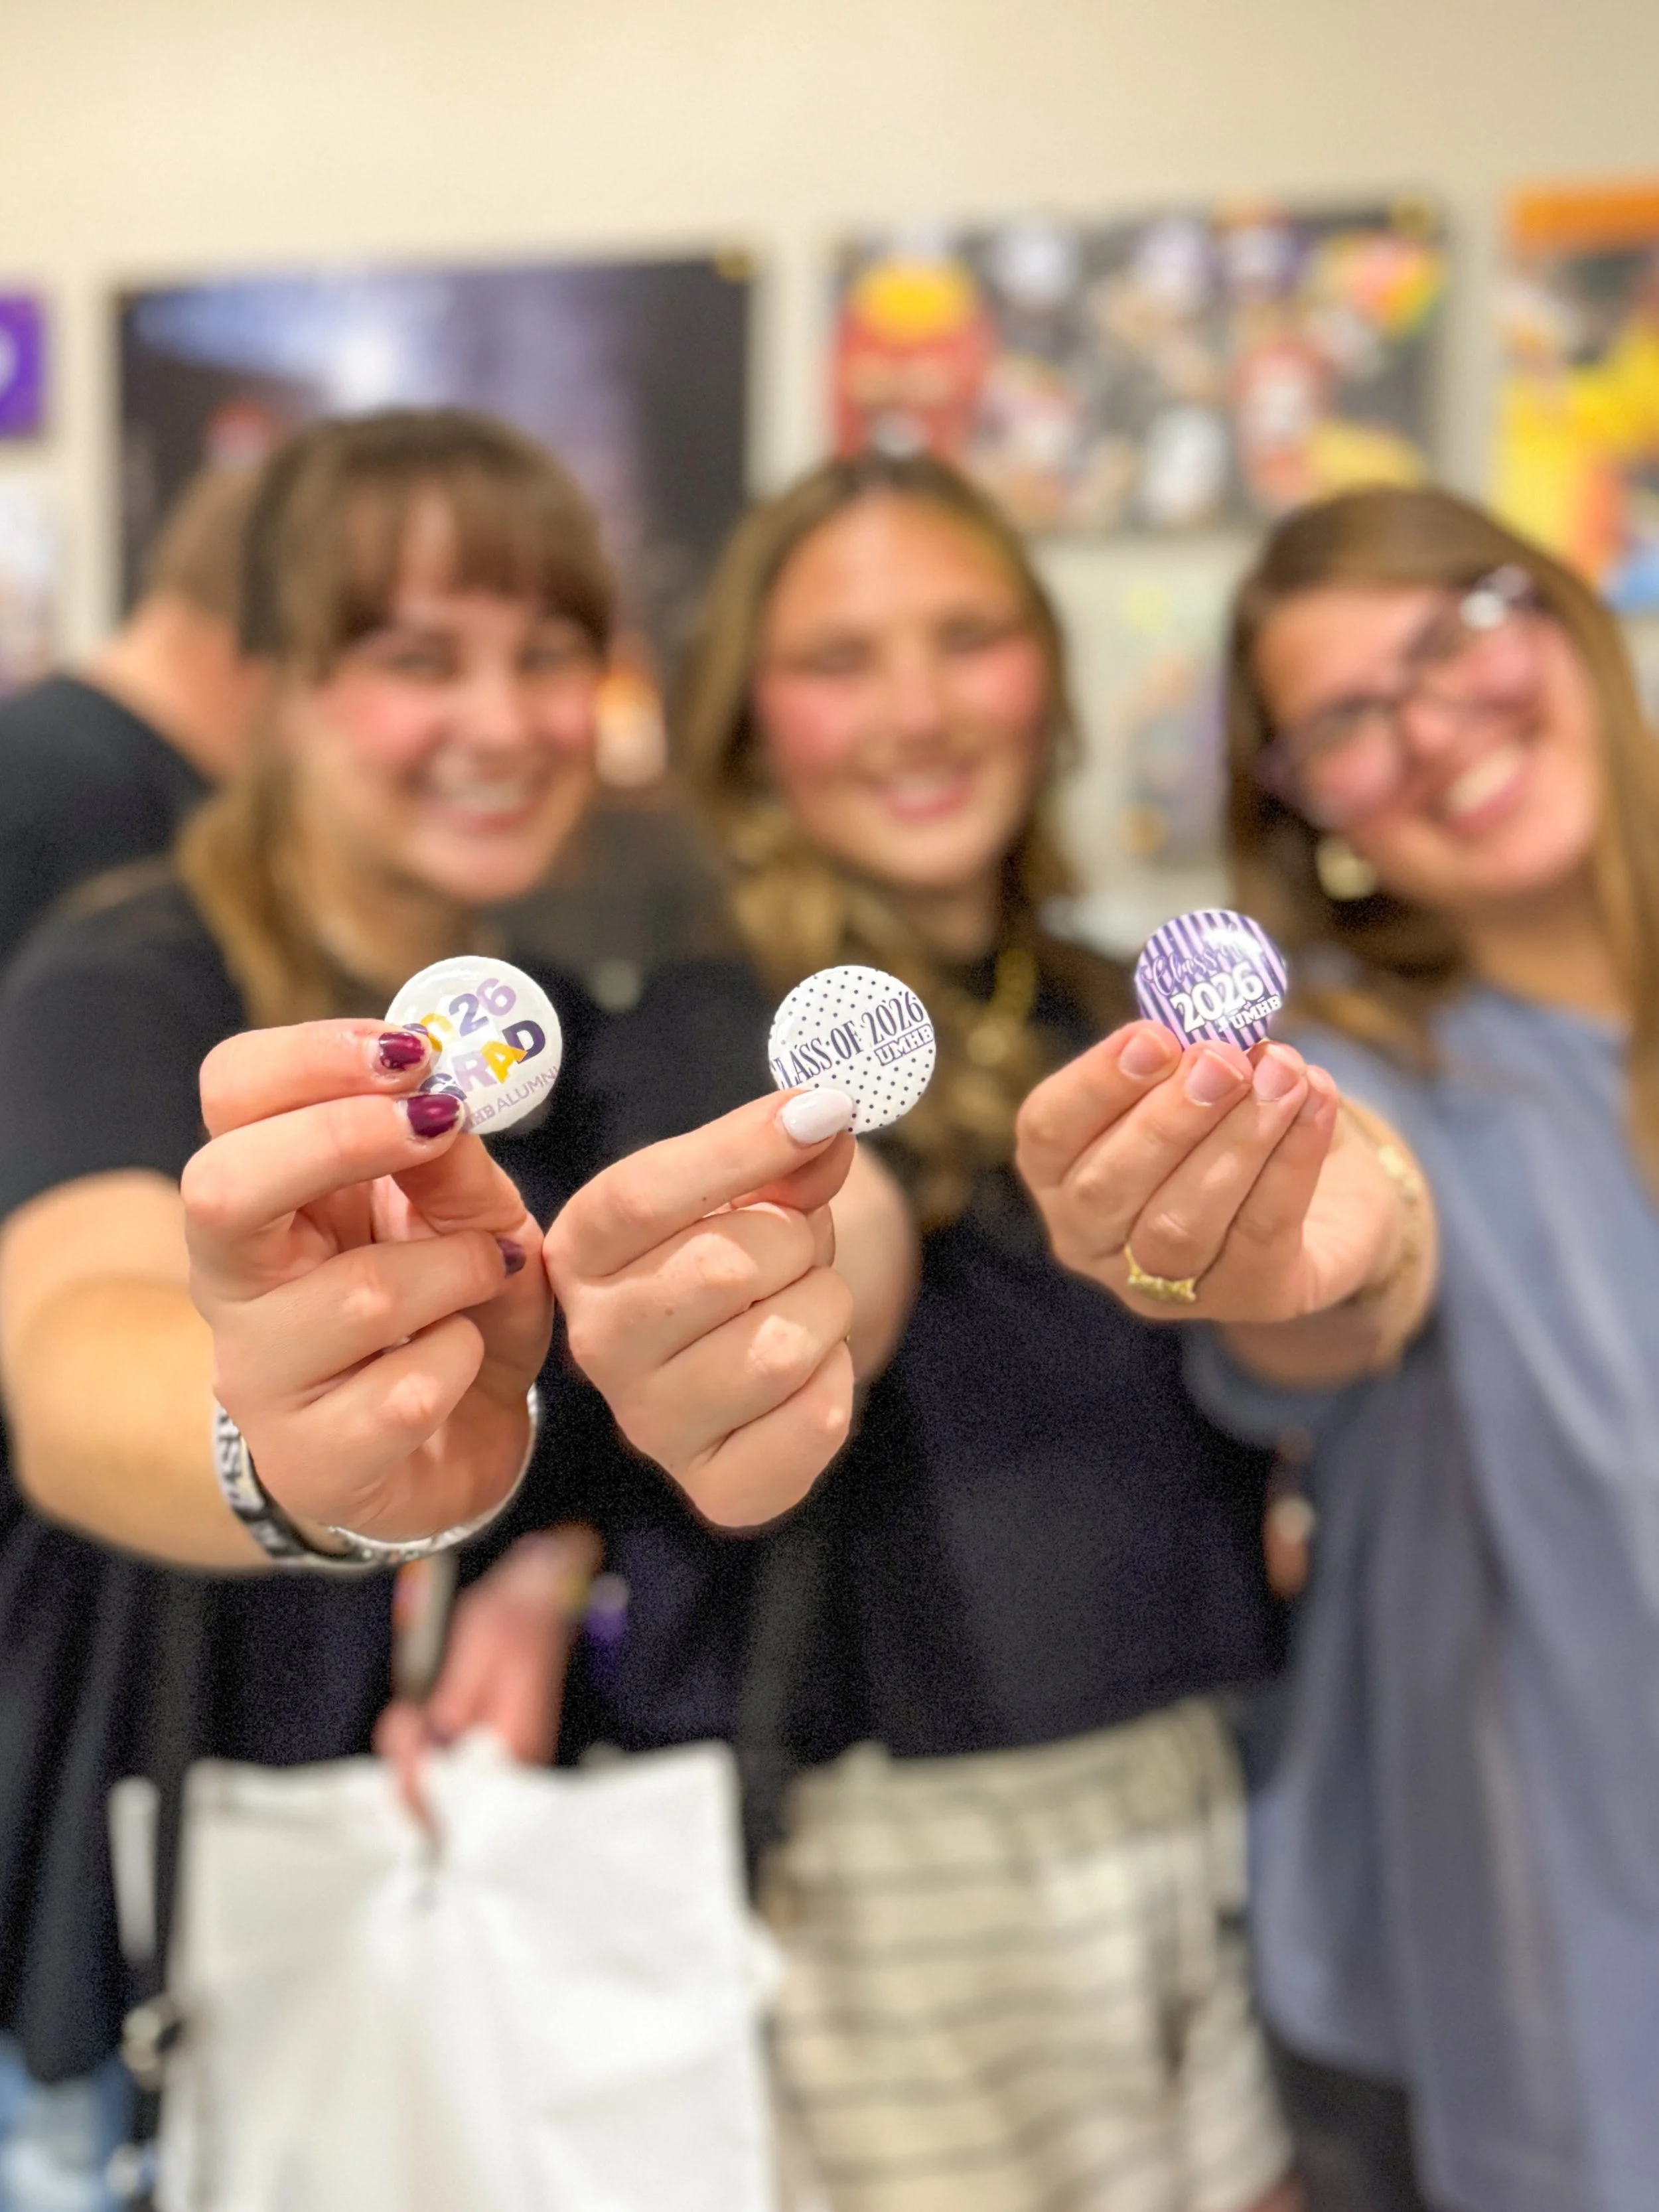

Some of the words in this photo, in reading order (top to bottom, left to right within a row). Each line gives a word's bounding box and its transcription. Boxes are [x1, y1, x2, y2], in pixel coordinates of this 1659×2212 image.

[1140, 944, 1218, 996] Class
[1170, 960, 1264, 1033] 2026
[402, 978, 517, 1053] 026
[770, 1037, 833, 1090] LASS
[830, 1020, 864, 1060] OF
[861, 991, 924, 1045] 2026
[1229, 994, 1282, 1029] UMHB
[873, 1023, 934, 1067] UMHB
[467, 1104, 496, 1127] HB
[496, 1065, 559, 1113] ALUMNI
